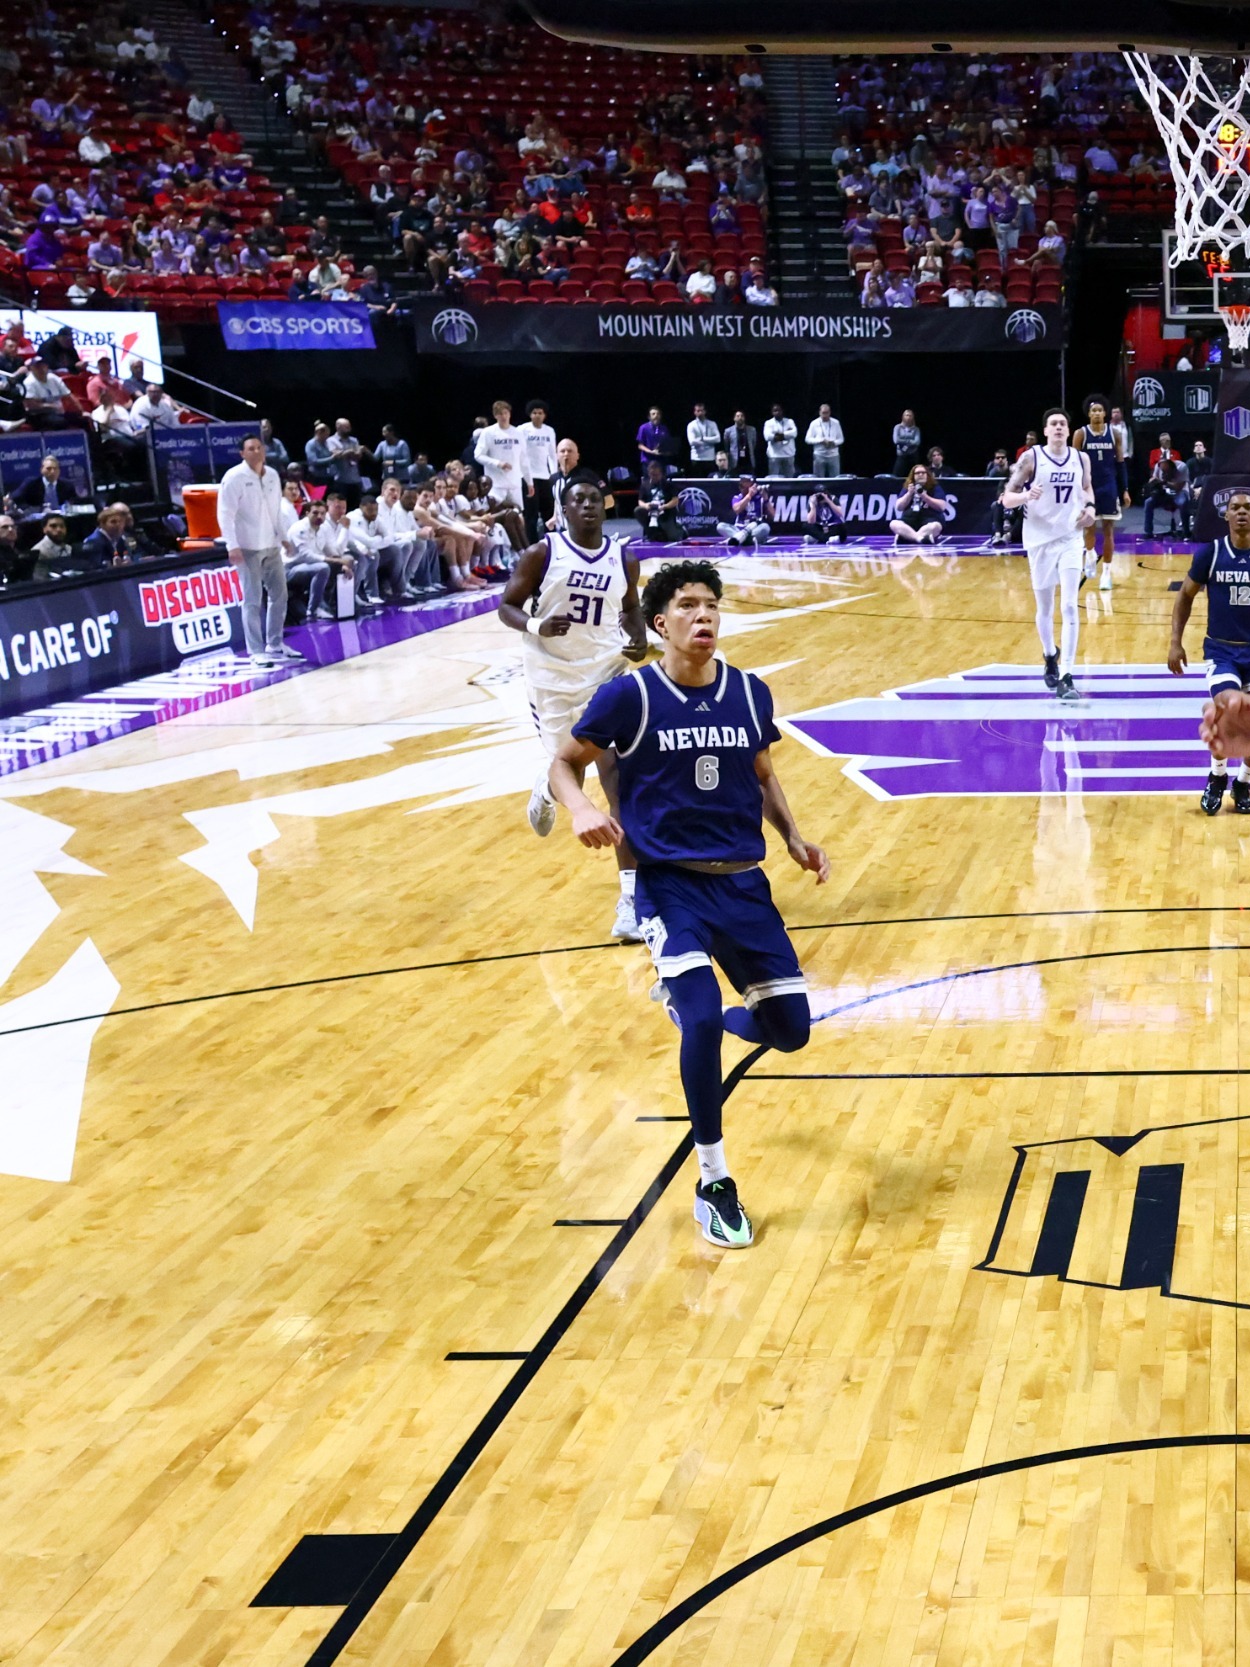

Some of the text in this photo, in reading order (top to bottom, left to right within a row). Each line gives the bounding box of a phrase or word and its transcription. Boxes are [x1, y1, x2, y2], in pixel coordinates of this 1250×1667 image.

[246, 317, 364, 334] CBS SPORTS
[599, 314, 892, 338] MOUNTAIN WEST CHAMPIONSHIPS
[1086, 442, 1113, 450] NEVADA
[1097, 450, 1103, 461] 1
[1049, 472, 1075, 483] GCU
[1053, 485, 1073, 504] 17
[1214, 492, 1230, 506] OLD
[566, 570, 612, 592] GCU
[140, 567, 243, 625] DISCOUNT
[1229, 586, 1250, 606] 12
[566, 593, 604, 626] 31
[179, 615, 224, 645] TIRE
[11, 622, 81, 676] CARE
[81, 614, 113, 658] OF
[657, 726, 750, 751] NEVADA
[695, 755, 719, 790] 6
